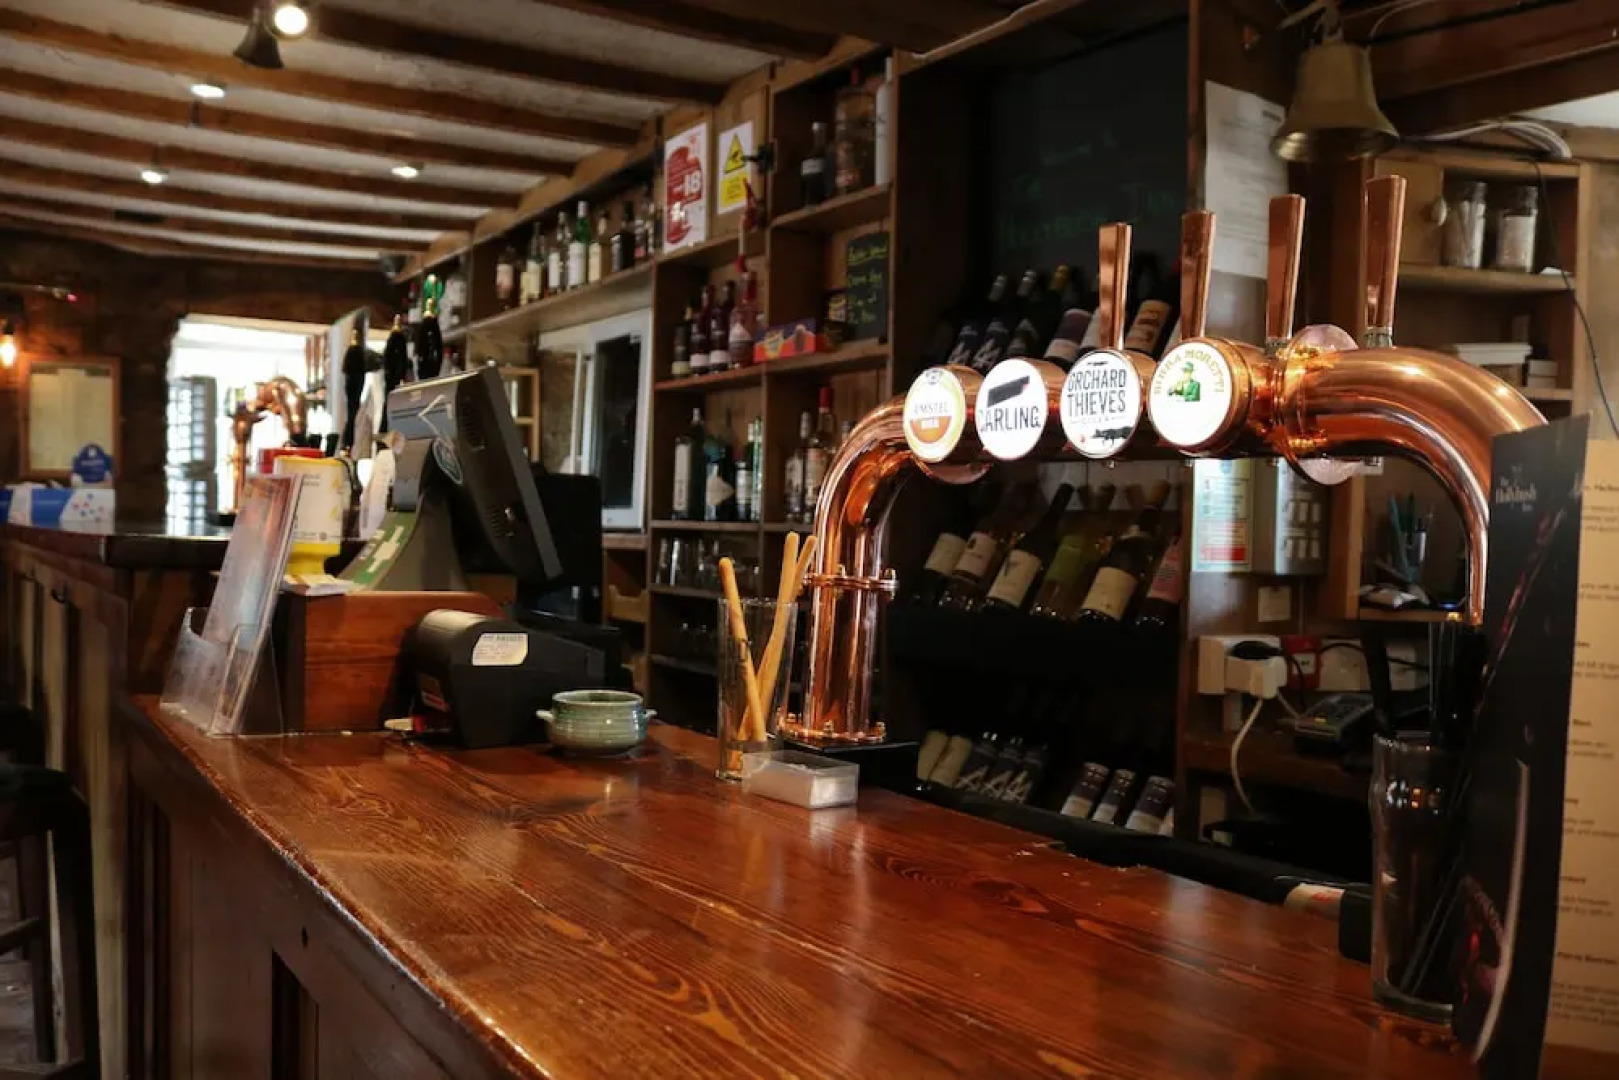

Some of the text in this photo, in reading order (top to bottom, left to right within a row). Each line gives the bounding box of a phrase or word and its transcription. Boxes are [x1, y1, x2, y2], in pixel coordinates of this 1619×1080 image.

[1067, 368, 1128, 392] ORCHARD
[1184, 349, 1225, 393] MORETTI
[912, 401, 950, 415] AMSTEL
[1066, 389, 1127, 417] THIEVES
